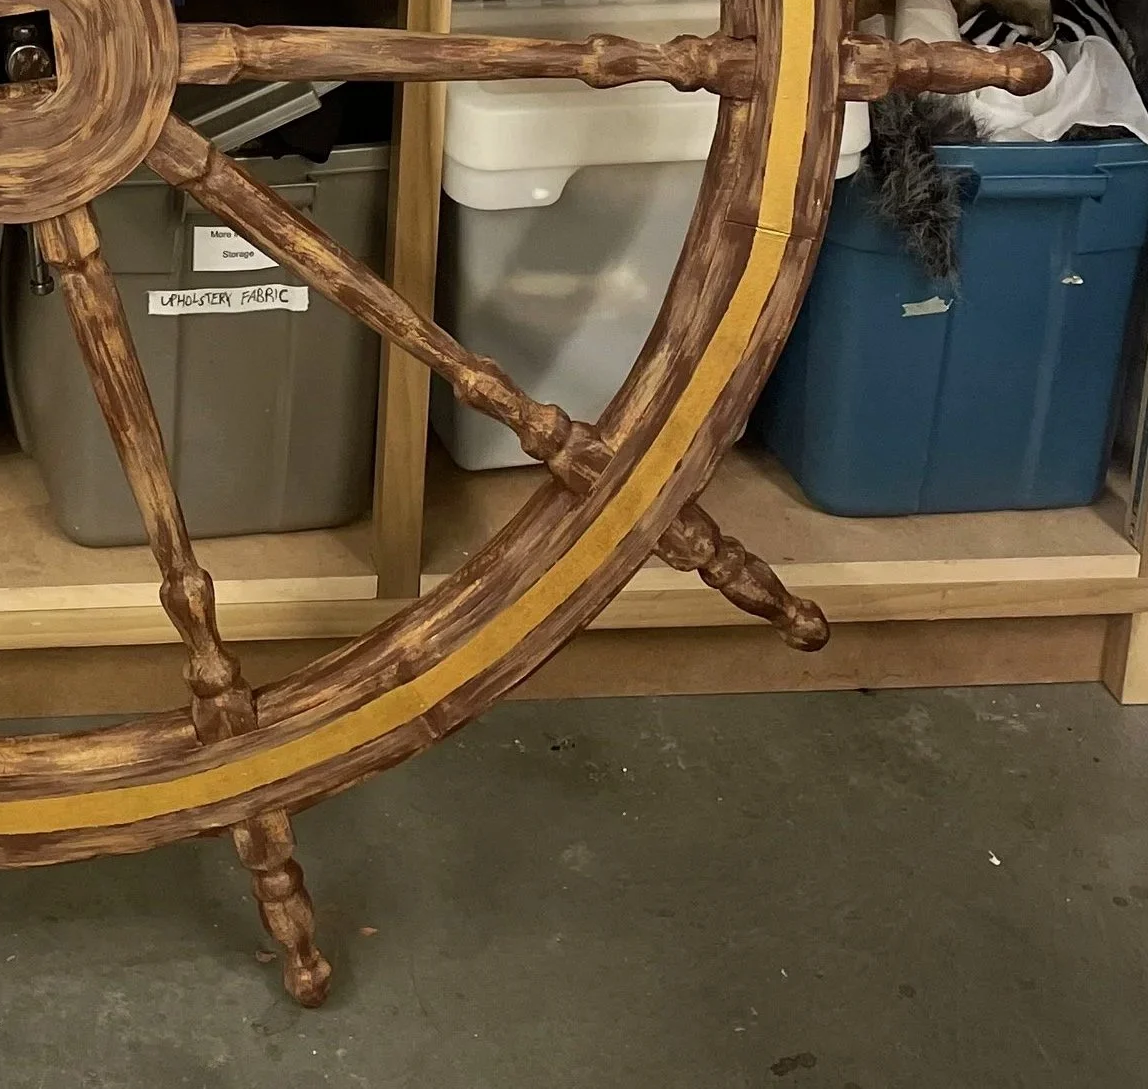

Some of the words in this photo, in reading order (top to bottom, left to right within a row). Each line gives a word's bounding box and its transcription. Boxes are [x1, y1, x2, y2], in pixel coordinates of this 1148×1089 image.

[222, 250, 255, 259] Storage
[160, 291, 232, 307] UPHOLSTERY
[240, 287, 289, 306] FABRIC
